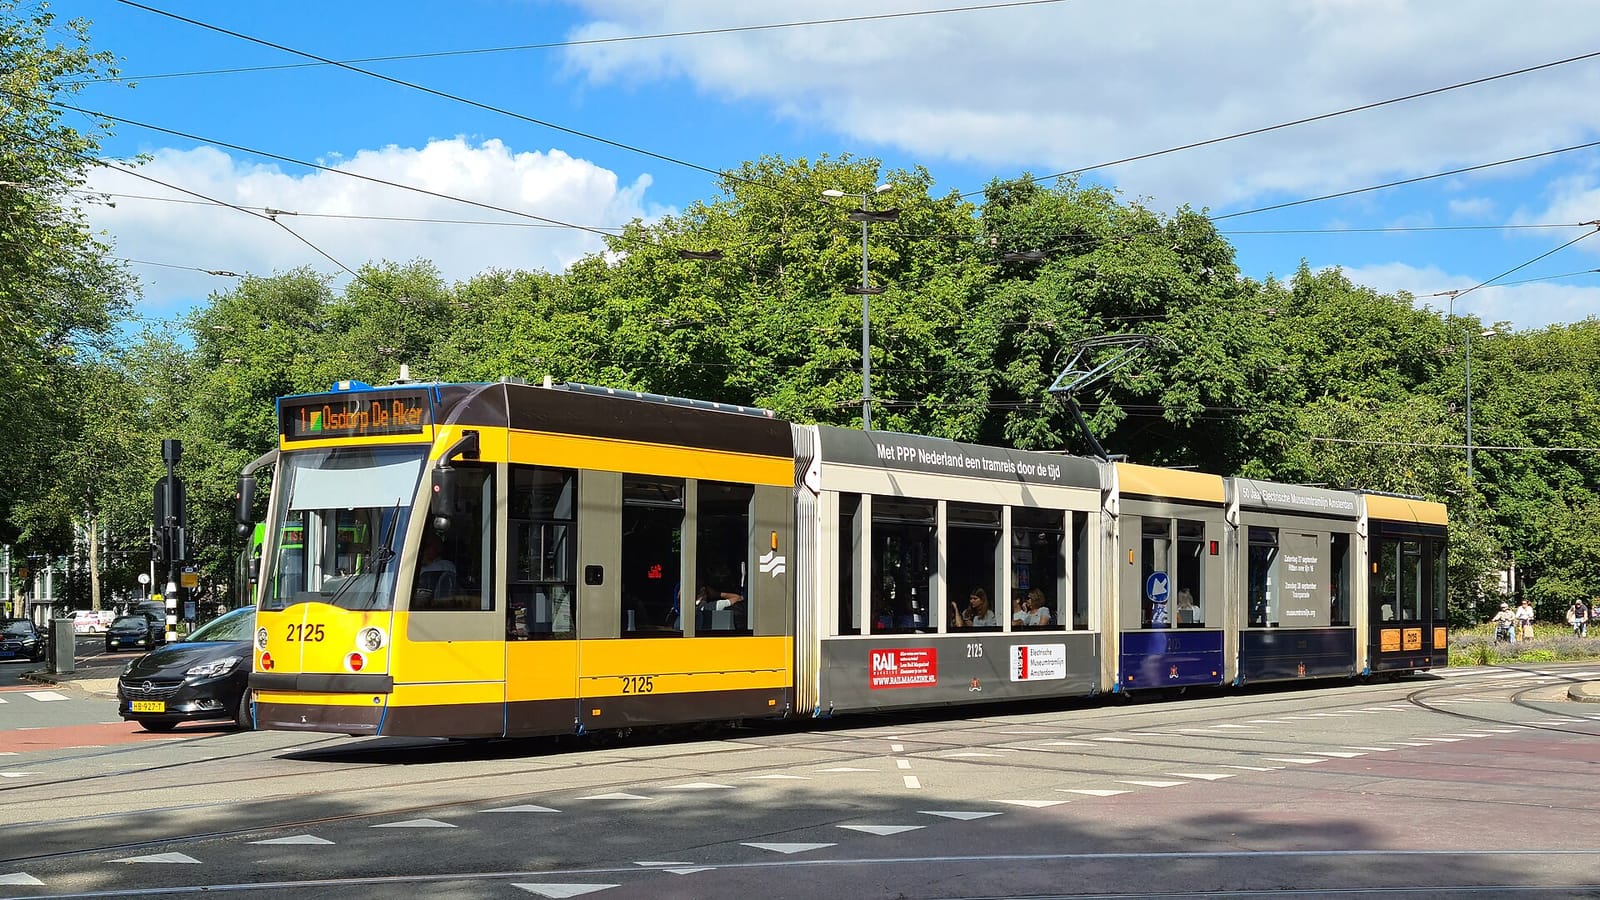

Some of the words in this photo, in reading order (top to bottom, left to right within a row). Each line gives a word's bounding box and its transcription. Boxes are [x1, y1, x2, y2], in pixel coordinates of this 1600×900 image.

[301, 407, 306, 432] 1
[322, 405, 369, 433] Osdorp
[372, 401, 389, 427] De
[393, 400, 422, 426] Aker
[876, 443, 895, 460] Met
[897, 446, 916, 462] PPP
[918, 448, 963, 468] Nederland
[965, 457, 981, 470] een
[982, 457, 1016, 473] tramreis
[1017, 461, 1035, 476] door
[1037, 464, 1047, 477] de
[1048, 464, 1061, 481] tijd
[1242, 487, 1250, 498] 50
[1262, 490, 1291, 503] Electrische
[286, 624, 325, 642] 2125
[967, 643, 983, 658] 2125
[1030, 648, 1052, 656] Electrische
[872, 652, 898, 671] RAIL
[622, 676, 653, 693] 2125
